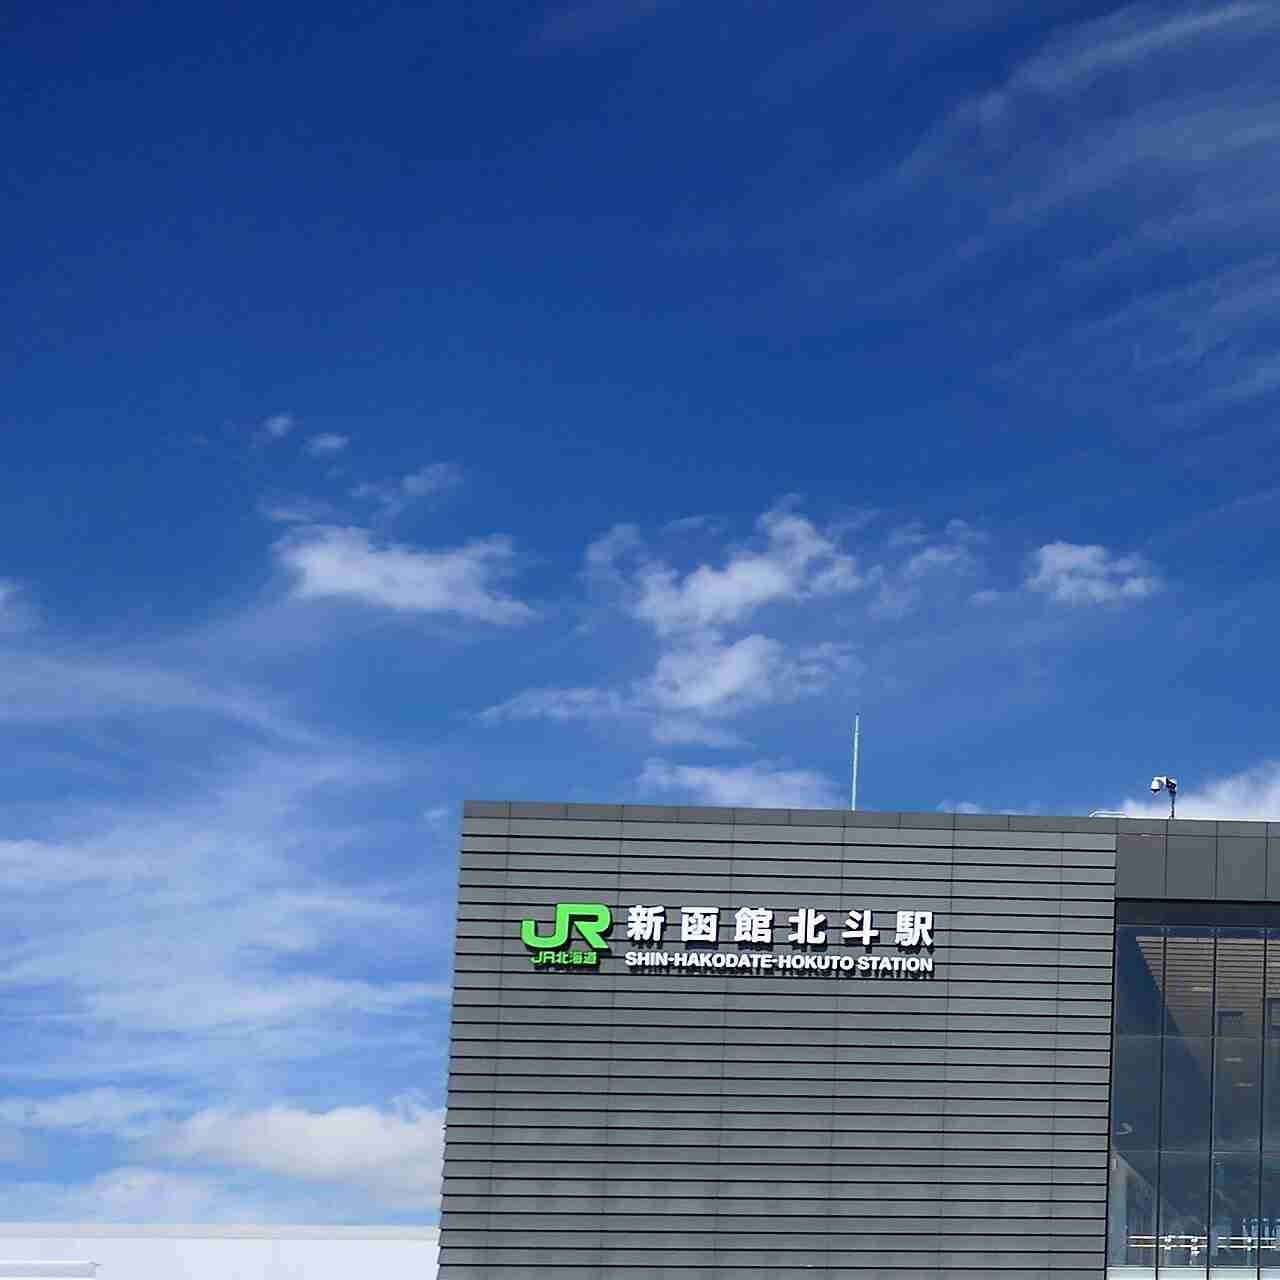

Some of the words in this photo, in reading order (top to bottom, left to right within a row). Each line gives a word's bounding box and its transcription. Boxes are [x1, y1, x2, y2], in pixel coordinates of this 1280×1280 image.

[521, 904, 610, 948] JR
[626, 904, 933, 946] 新函館北斗駅
[531, 951, 597, 965] JR北海道
[625, 951, 854, 970] SHIN-HAKODATE-HOKUTO
[857, 956, 933, 972] STATION
